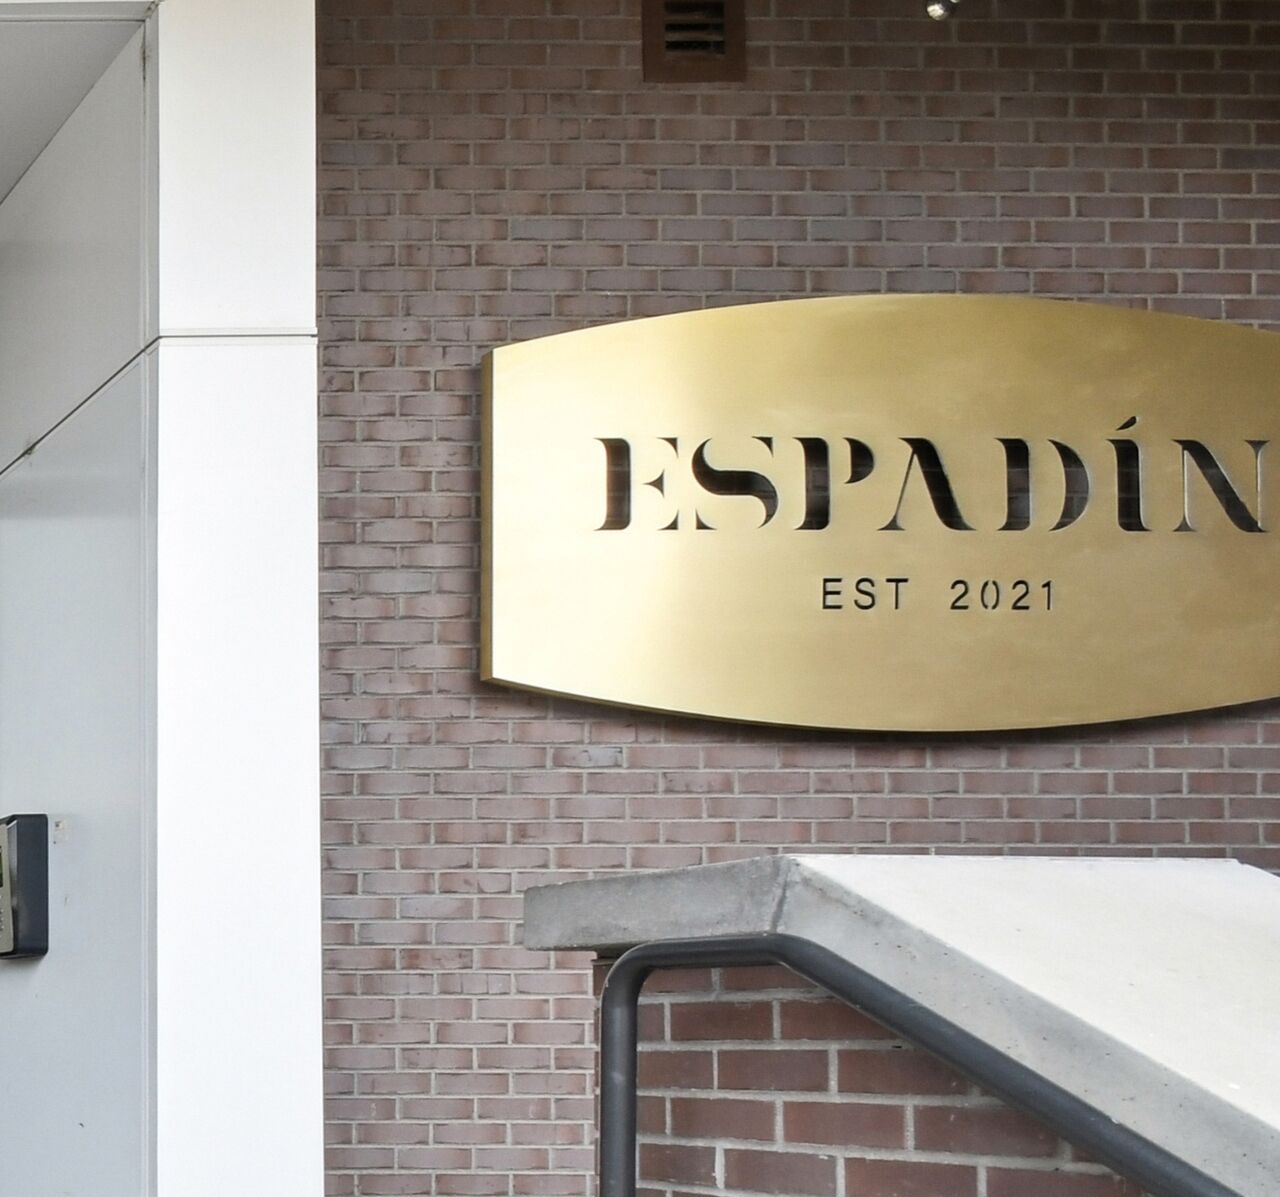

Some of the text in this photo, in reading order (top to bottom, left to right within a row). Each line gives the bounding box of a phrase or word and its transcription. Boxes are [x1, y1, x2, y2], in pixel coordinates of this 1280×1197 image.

[594, 415, 1269, 533] ESPADÍN
[822, 577, 1052, 611] EST 2021
